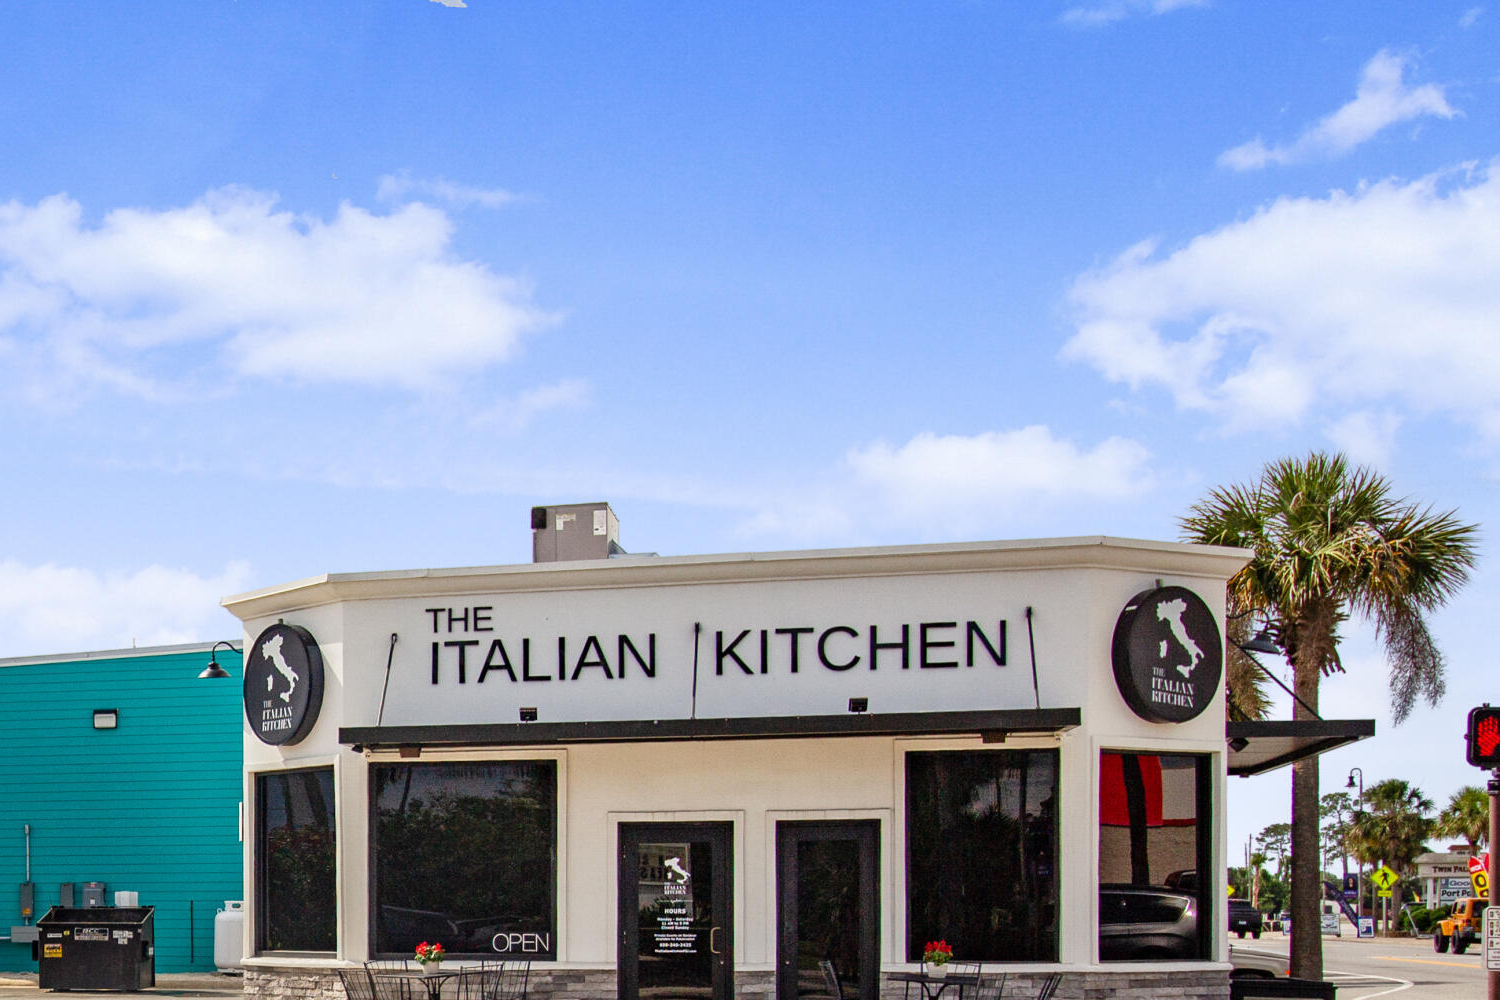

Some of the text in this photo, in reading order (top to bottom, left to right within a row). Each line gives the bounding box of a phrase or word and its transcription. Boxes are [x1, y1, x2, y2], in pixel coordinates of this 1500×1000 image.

[425, 606, 494, 633] THE
[431, 620, 1008, 685] ITALIAN KITCHEN
[1151, 677, 1194, 695] ITALIAN
[1151, 690, 1194, 708] KITCHEN
[262, 706, 292, 720] ITALIAN
[262, 718, 292, 732] KITCHEN
[1441, 889, 1460, 897] Port
[492, 932, 550, 952] OPEN
